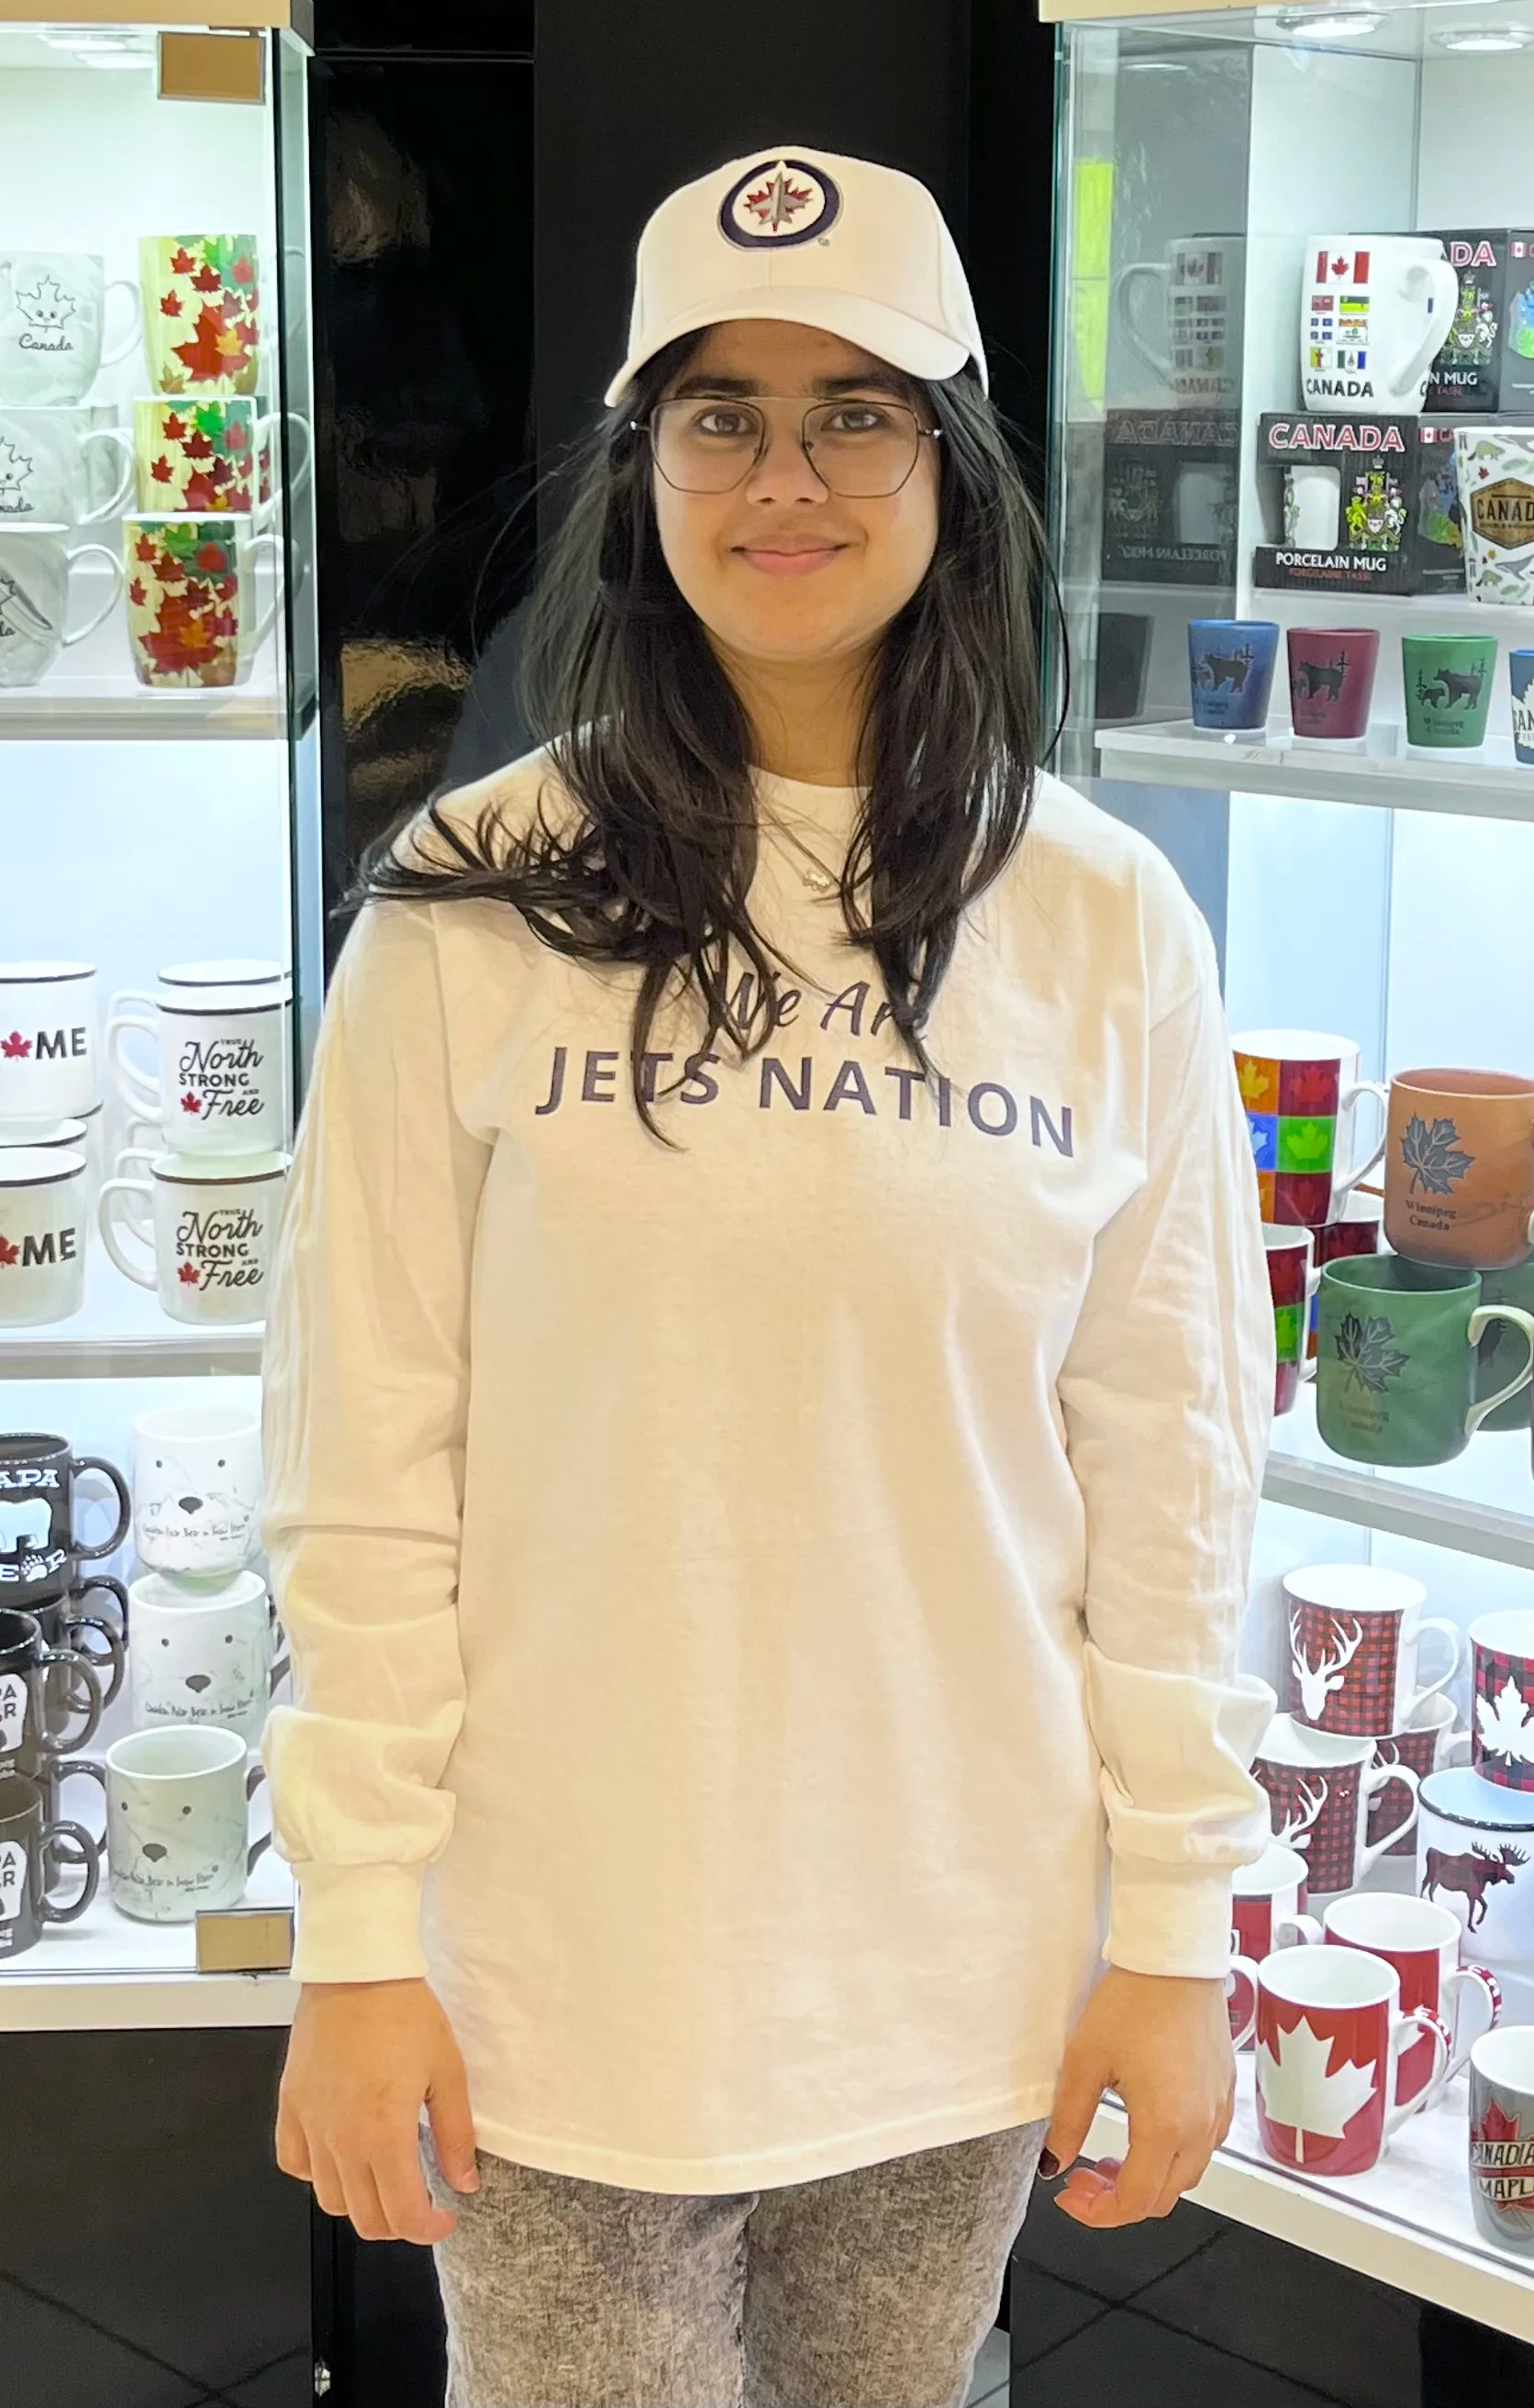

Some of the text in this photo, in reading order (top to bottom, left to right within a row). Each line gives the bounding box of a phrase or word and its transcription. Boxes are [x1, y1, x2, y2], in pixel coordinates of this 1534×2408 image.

[1440, 240, 1497, 267] DA
[18, 333, 73, 350] Canada
[1306, 379, 1374, 398] CANADA
[1444, 371, 1478, 385] MUG
[1269, 423, 1406, 453] CANADA
[1275, 551, 1387, 571] PORCELAIN MUG
[819, 980, 913, 1037] Ar
[36, 1026, 88, 1060] ME
[179, 1038, 265, 1073] North
[179, 1072, 250, 1088] STRONG
[201, 1089, 264, 1121] Free
[535, 1047, 1074, 1158] JETS NATION
[1406, 1199, 1457, 1220] Winnipeg
[1409, 1215, 1450, 1231] Canada
[176, 1208, 264, 1244] North
[22, 1227, 77, 1267] ME
[175, 1242, 250, 1258] STRONG
[199, 1259, 264, 1292] Free
[1479, 2179, 1534, 2200] MAPL
